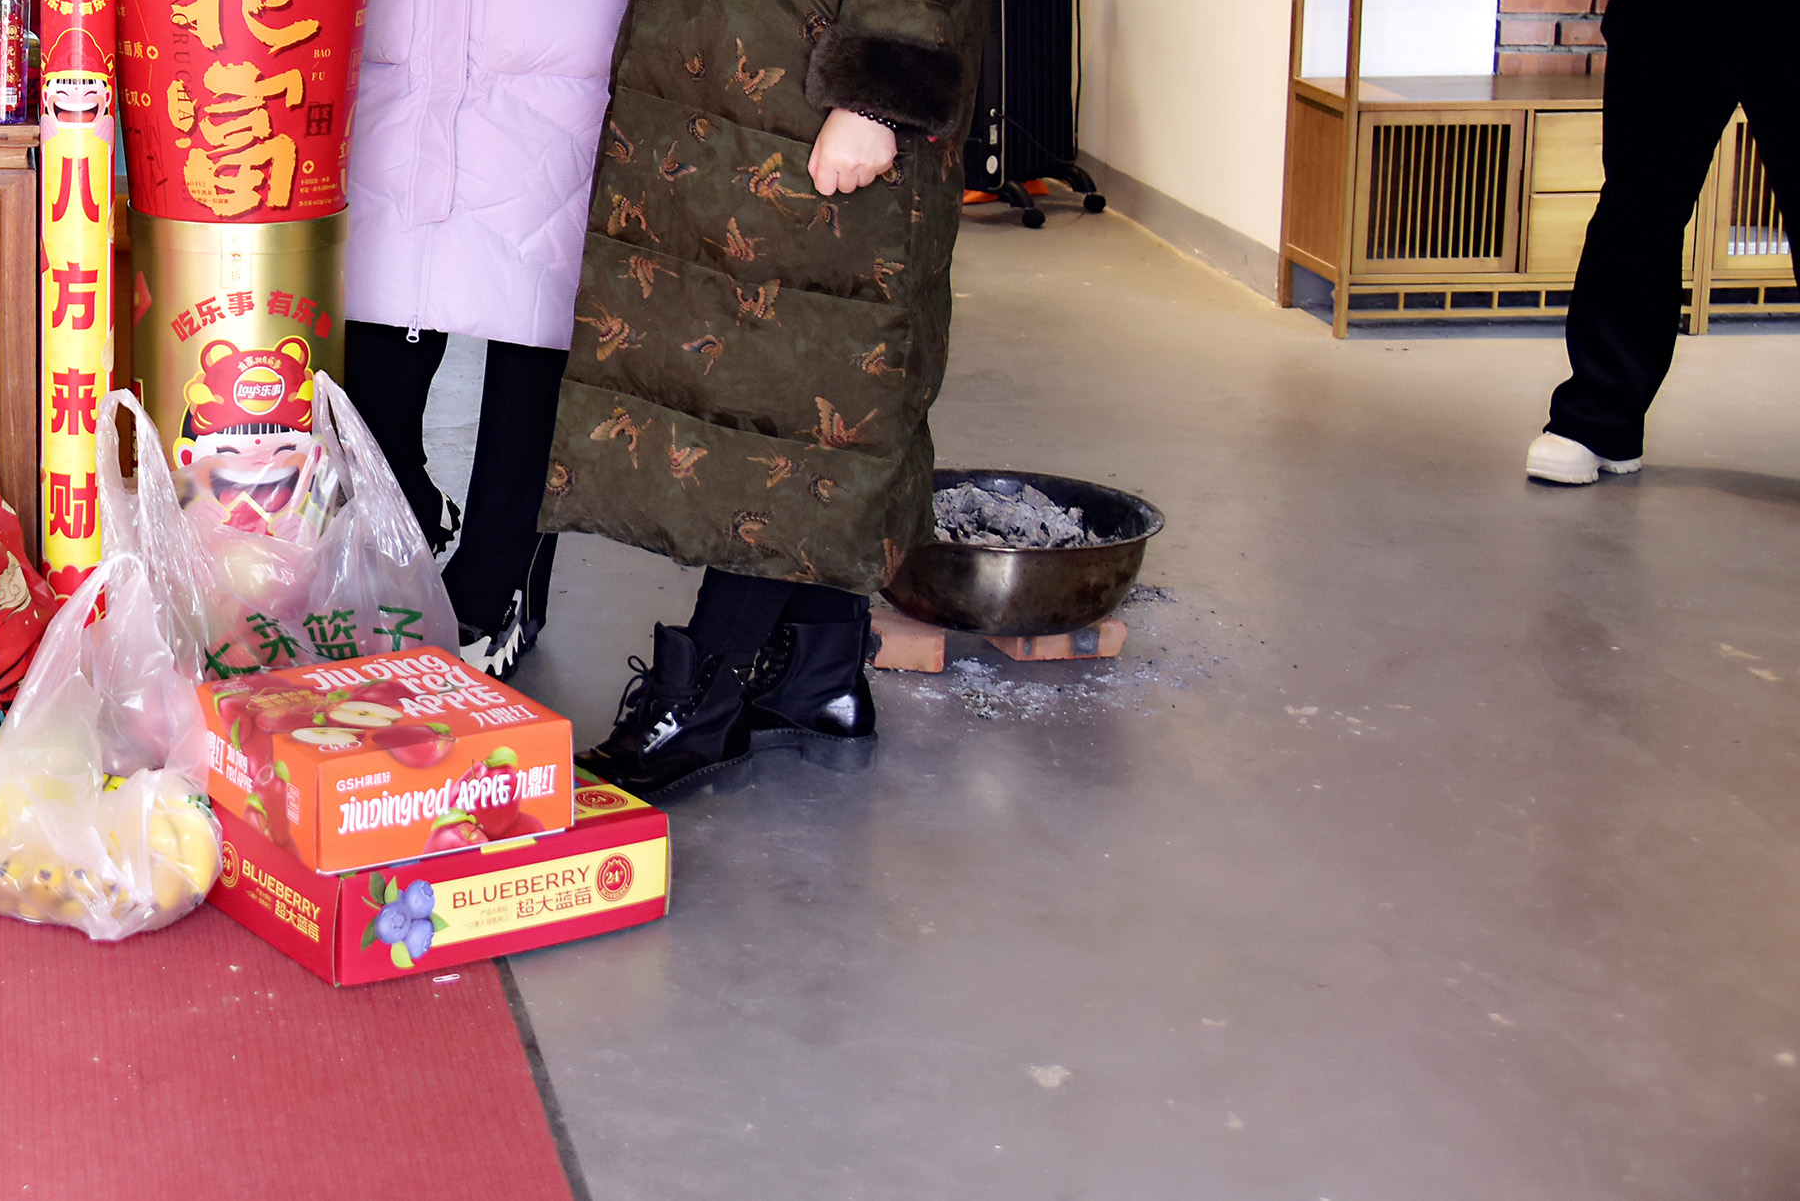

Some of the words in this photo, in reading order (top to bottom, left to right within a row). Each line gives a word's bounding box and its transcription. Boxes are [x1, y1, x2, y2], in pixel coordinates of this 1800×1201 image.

[313, 48, 331, 59] BAO
[311, 71, 326, 82] FU
[170, 290, 255, 343] 吃乐事
[266, 289, 333, 340] 有乐事
[49, 155, 101, 540] 八方来财
[398, 663, 484, 696] red
[398, 685, 507, 718] APPLE
[468, 703, 539, 728] 九鼎红
[454, 773, 512, 812] APPLE
[512, 764, 557, 801] 九鼎红
[241, 858, 322, 921] BLUEBERRY
[452, 865, 591, 910] BLUEBERRY
[515, 886, 593, 920] 超大蓝莓
[274, 898, 320, 940] 超大蓝莓
